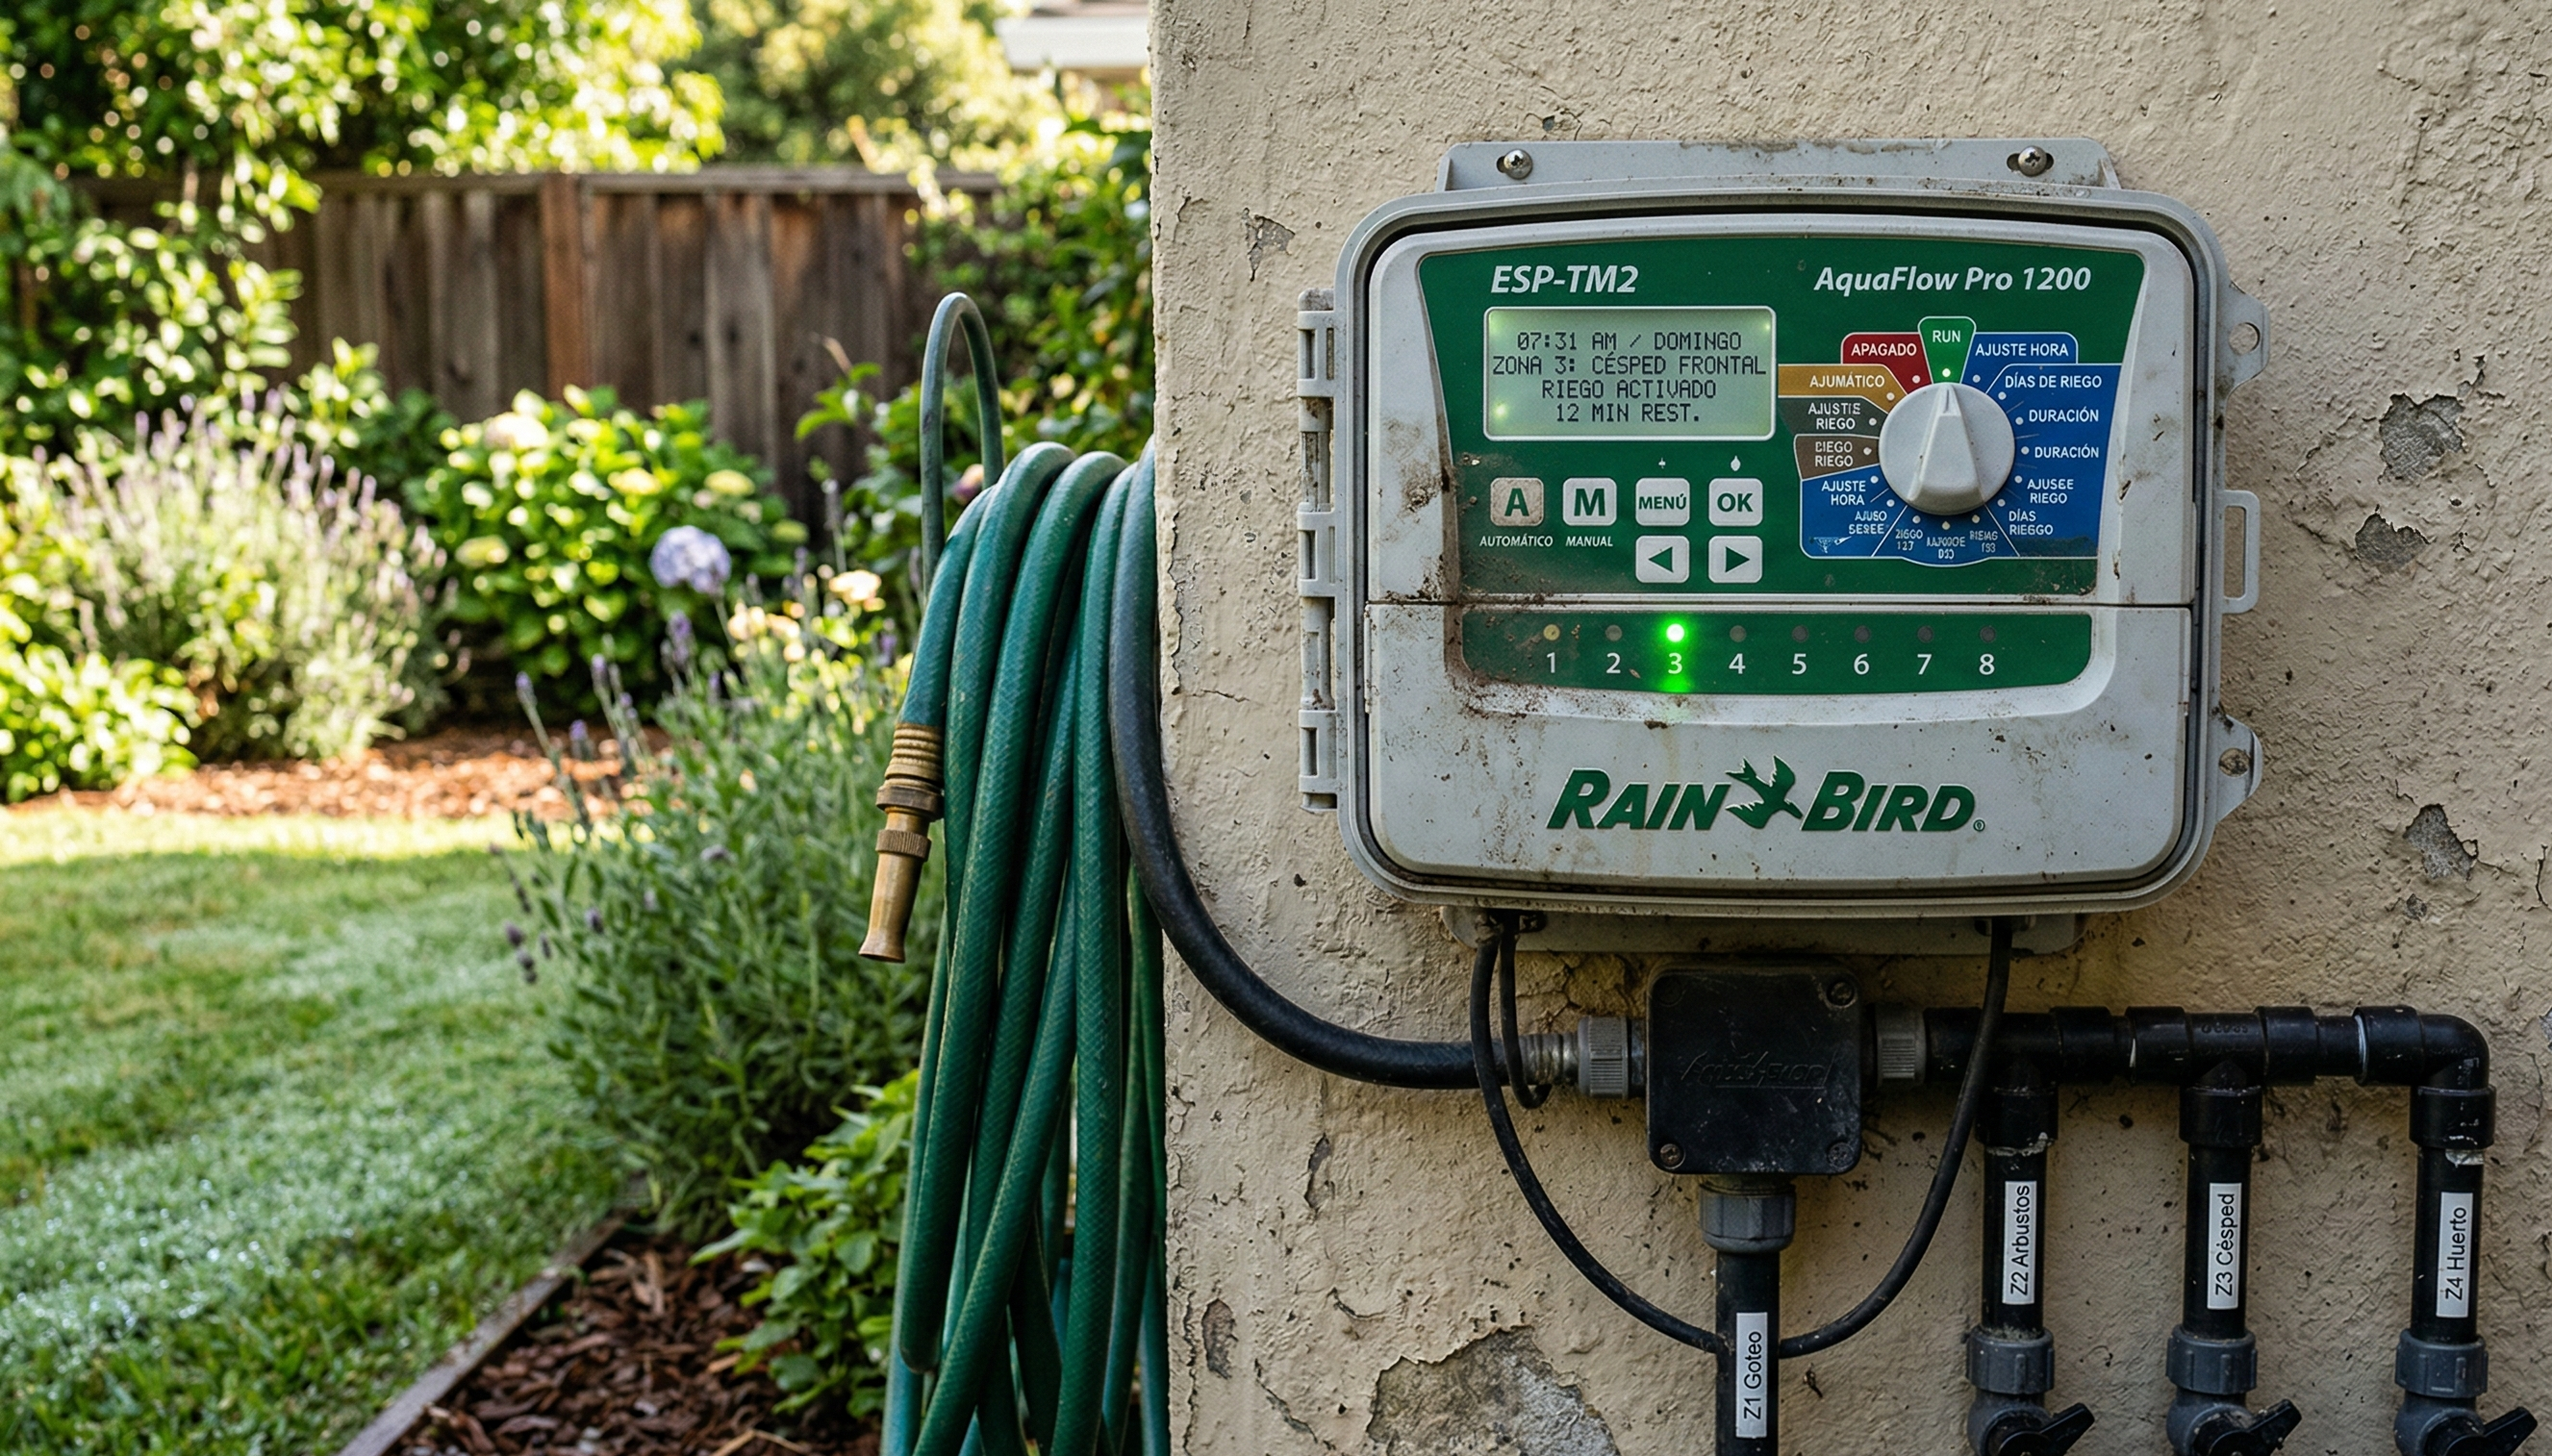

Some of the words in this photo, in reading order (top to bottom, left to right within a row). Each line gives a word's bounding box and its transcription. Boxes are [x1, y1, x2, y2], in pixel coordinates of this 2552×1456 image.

[1491, 264, 1638, 293] ESP-TM2
[1813, 265, 1958, 297] AquaFlow
[1964, 266, 2013, 290] Pro
[2023, 266, 2091, 290] 1200
[1517, 332, 1578, 351] 07:31
[1591, 332, 1617, 351] AM
[1629, 334, 1641, 349] /
[1654, 332, 1742, 351] DOMINGO
[1933, 330, 1960, 342] RUN
[1851, 343, 1917, 356] APAGADO
[1975, 343, 2027, 356] AJUSTE
[2031, 343, 2068, 356] HORA
[1493, 355, 1541, 375] ZONA
[1554, 356, 1576, 375] 3:
[1591, 352, 1666, 375] CÉSPED
[1680, 356, 1766, 375] FRONTAL
[1809, 371, 1884, 388] AJUMÁTICO
[2005, 371, 2035, 388] DÍAS
[2039, 375, 2057, 388] DE
[2060, 375, 2102, 388] RIEGO
[1542, 380, 1604, 399] RIEGO
[1616, 380, 1716, 399] ACTIVADO
[1555, 403, 1579, 422] 12
[1591, 403, 1630, 422] MIN
[1641, 403, 1700, 422] REST.
[2029, 406, 2099, 422] DURACIÓN
[1816, 417, 1856, 430] RIEGO
[2034, 443, 2099, 458] DURACIÓN
[1815, 455, 1854, 467] RIEGO
[1821, 480, 1866, 492] AJUSTE
[1503, 488, 1529, 516] A
[1574, 488, 1606, 516] M
[1638, 493, 1687, 510] MENÚ
[1717, 492, 1754, 513] OK
[1831, 493, 1865, 506] HORA
[2030, 492, 2067, 504] RIEGO
[2009, 508, 2036, 521] DÍAS
[1479, 534, 1554, 547] AUTOMÁTICO
[1565, 536, 1613, 547] MANUAL
[1546, 652, 1556, 673] 1
[1606, 652, 1621, 673] 2
[1668, 652, 1682, 674] 3
[1729, 652, 1745, 674] 4
[1792, 652, 1807, 674] 5
[1854, 652, 1869, 674] 6
[1916, 653, 1933, 674] 7
[1979, 652, 1995, 674] 8
[1546, 767, 1731, 830] RAIN
[1800, 770, 1976, 832] BIRD
[2011, 1185, 2031, 1268] Arbustos
[2447, 1207, 2466, 1269] Huerto
[2010, 1271, 2029, 1295] Z2
[2215, 1271, 2233, 1296] Z3
[2445, 1277, 2464, 1300] Z4
[1744, 1331, 1762, 1389] Goteo
[1744, 1397, 1761, 1419] Z1
